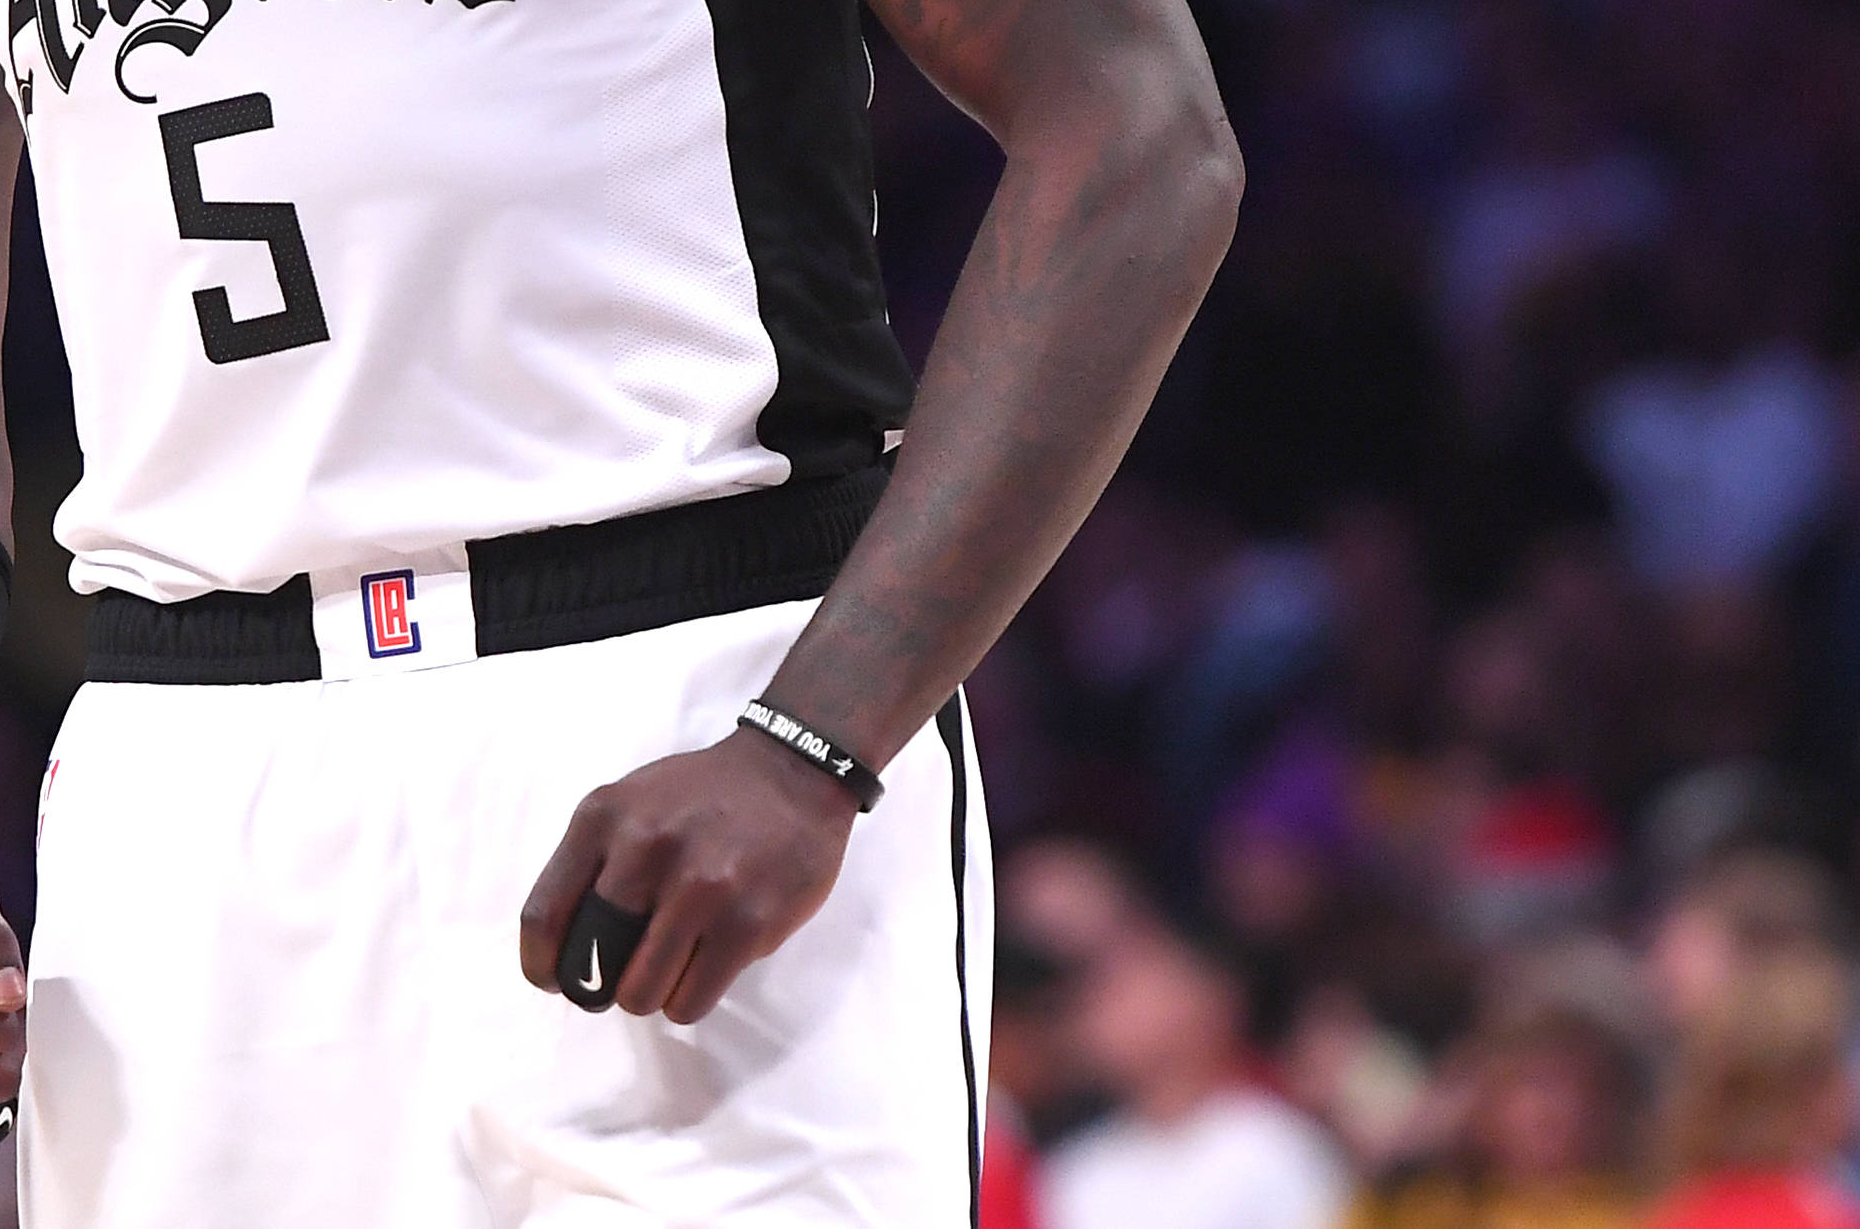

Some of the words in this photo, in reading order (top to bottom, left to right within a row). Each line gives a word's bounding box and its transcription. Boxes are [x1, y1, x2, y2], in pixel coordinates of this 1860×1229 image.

[157, 92, 330, 365] 5
[771, 715, 802, 741] ARE
[796, 732, 831, 762] YOU
